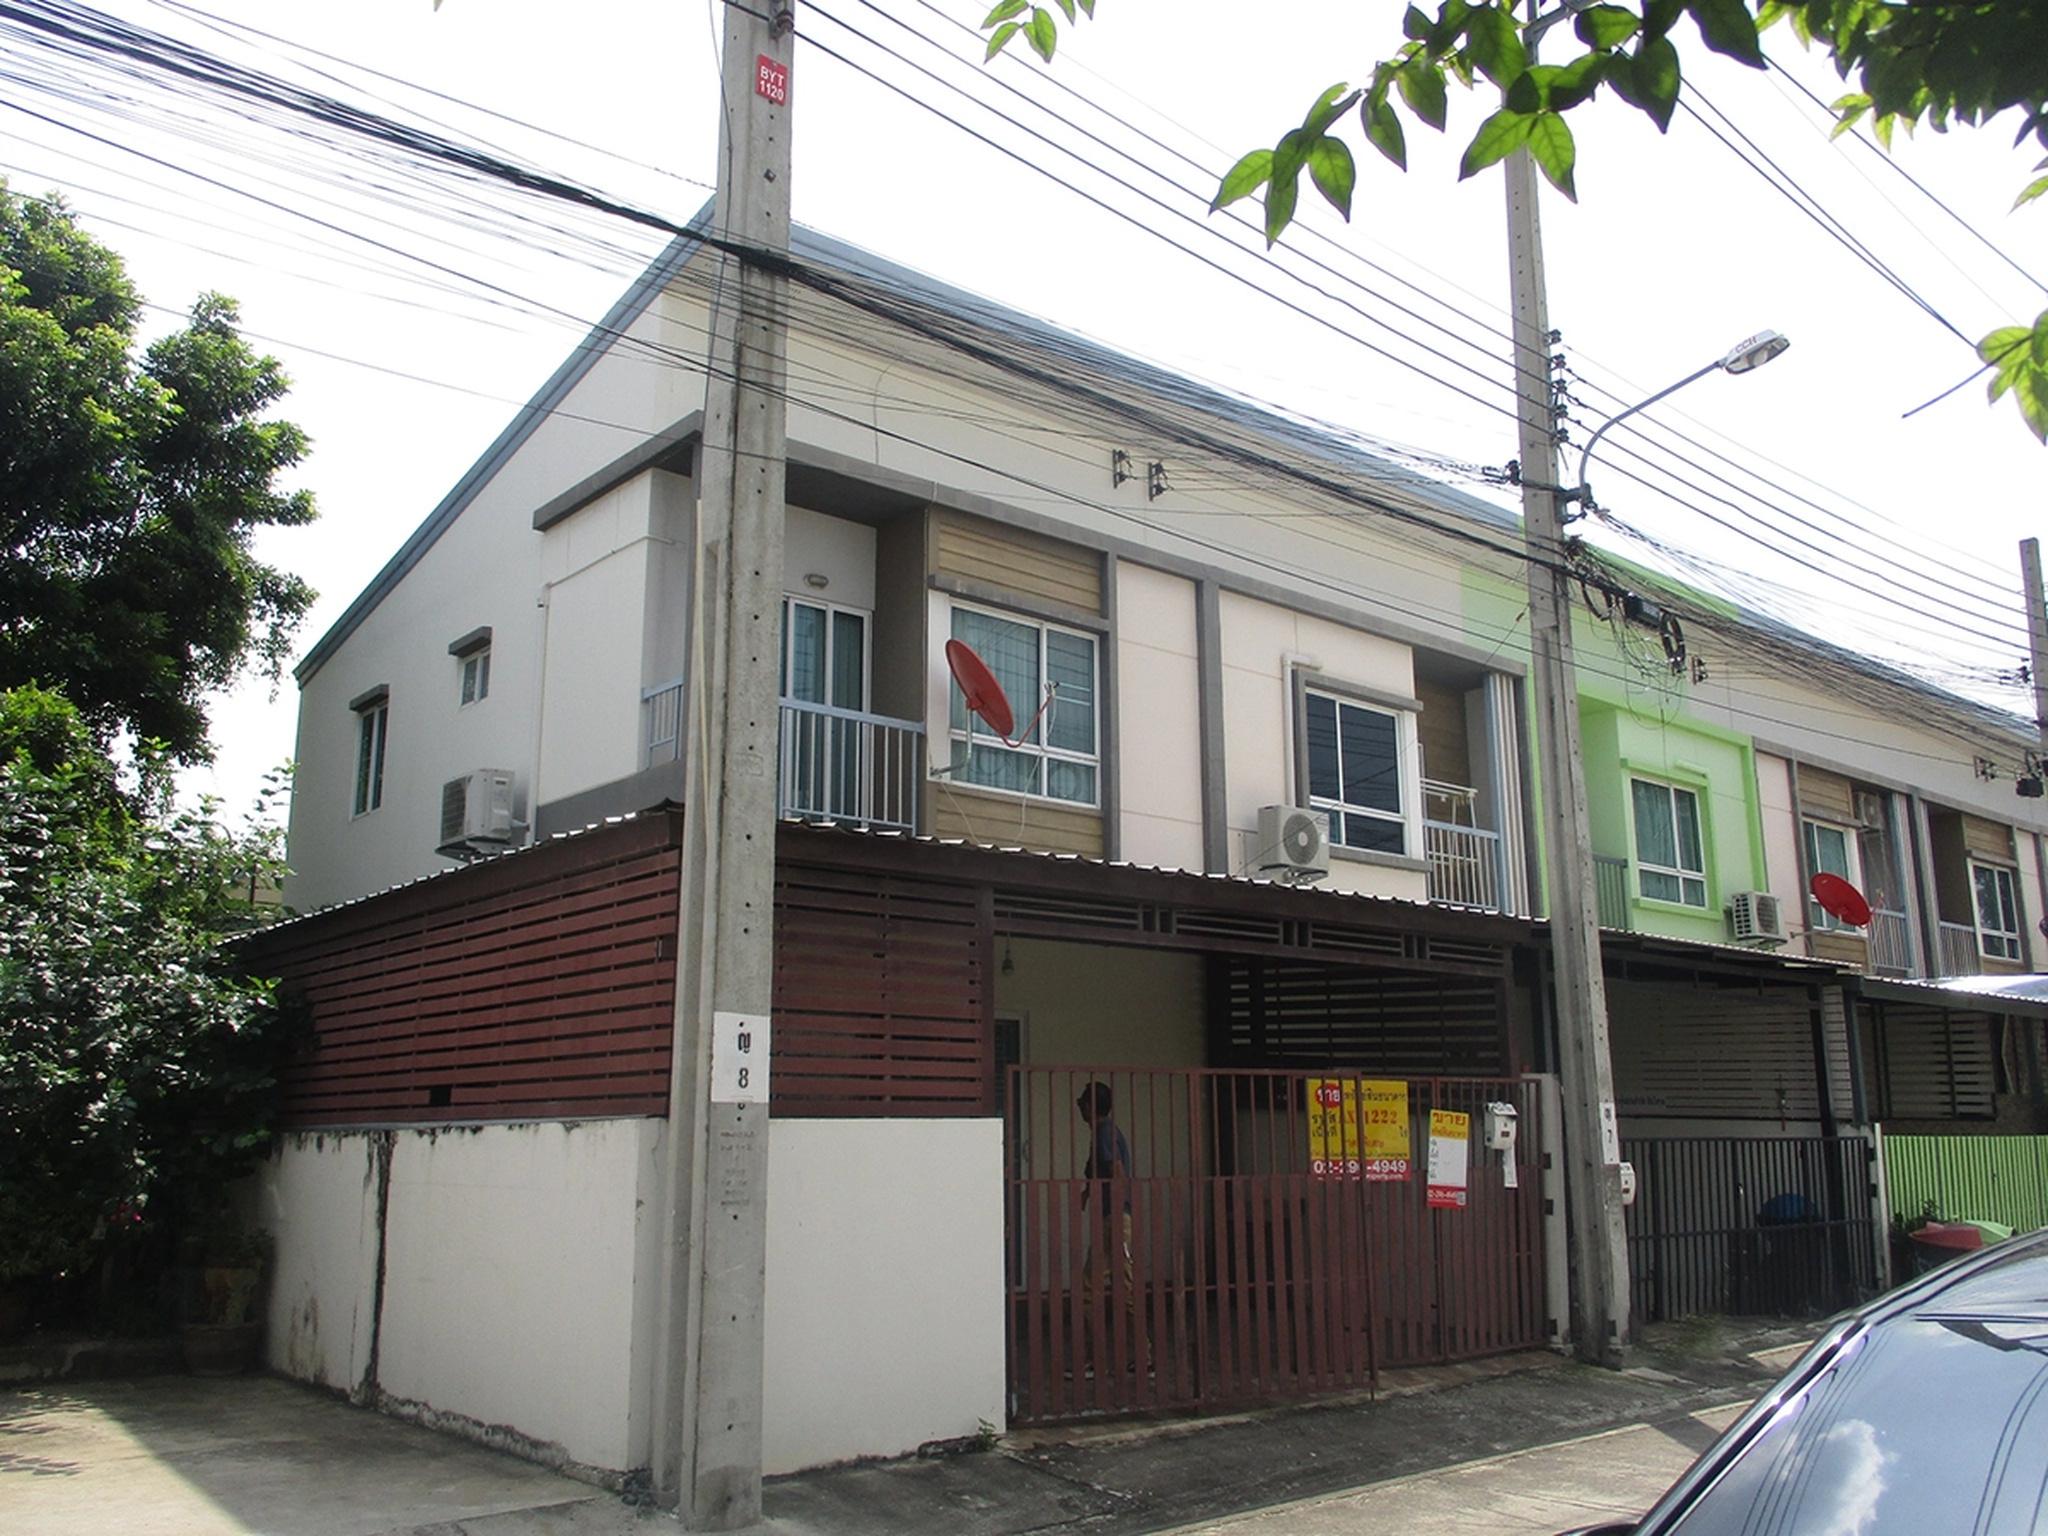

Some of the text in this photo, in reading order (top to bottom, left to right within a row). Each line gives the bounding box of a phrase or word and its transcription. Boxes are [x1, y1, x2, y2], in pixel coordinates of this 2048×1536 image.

[760, 65, 785, 87] BYT
[760, 80, 784, 101] 1120
[738, 1067, 749, 1089] 8
[1432, 1111, 1467, 1126] ขาย
